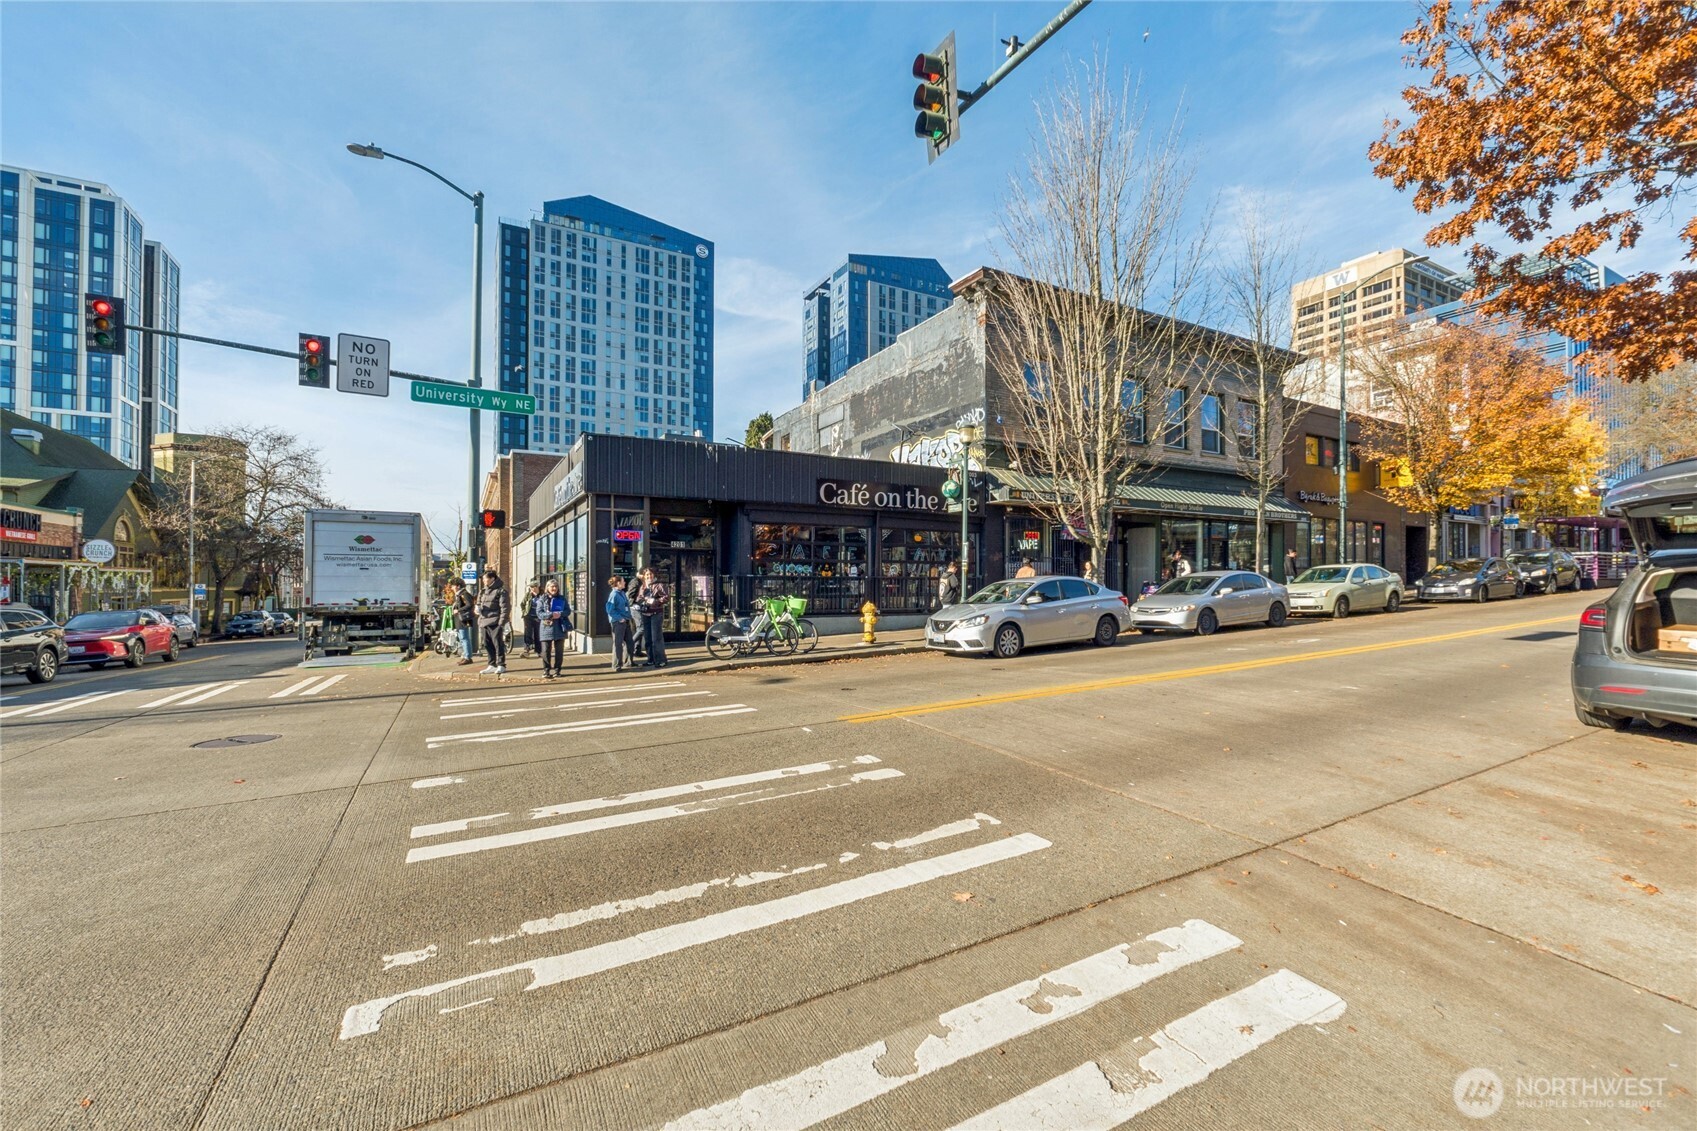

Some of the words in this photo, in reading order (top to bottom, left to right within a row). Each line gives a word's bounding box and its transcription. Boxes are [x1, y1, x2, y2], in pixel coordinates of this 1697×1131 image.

[698, 247, 706, 255] S
[1331, 270, 1350, 286] W
[352, 341, 376, 355] NO
[349, 354, 379, 367] TURN
[355, 367, 371, 378] ON
[352, 378, 375, 389] RED
[415, 386, 484, 407] University
[492, 396, 507, 409] Wy
[516, 399, 531, 410] NE
[819, 482, 870, 506] Café
[874, 490, 901, 508] on
[905, 487, 938, 510] the
[615, 531, 641, 540] OPEN
[1017, 539, 1038, 550] VAPE
